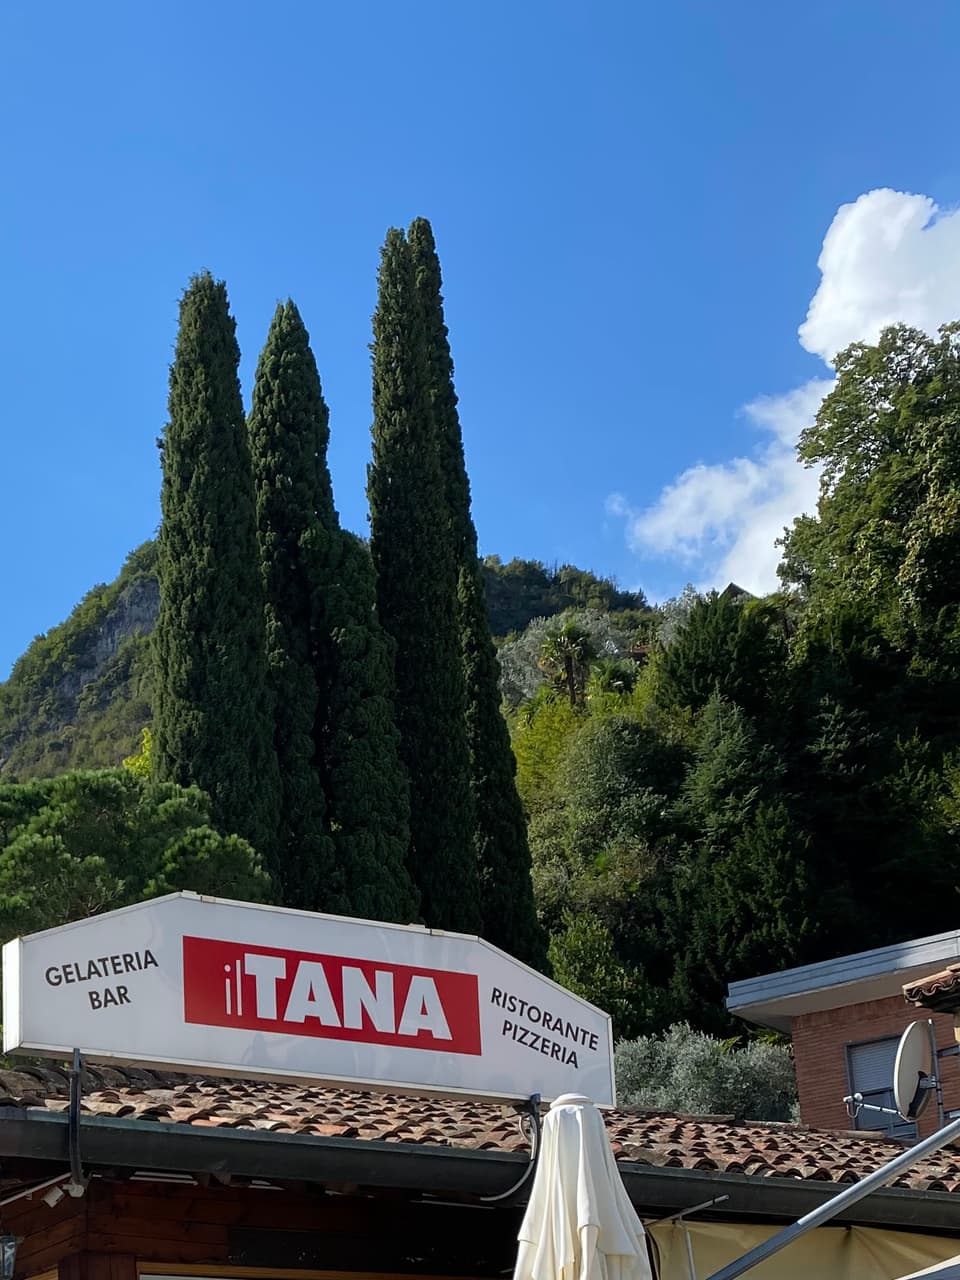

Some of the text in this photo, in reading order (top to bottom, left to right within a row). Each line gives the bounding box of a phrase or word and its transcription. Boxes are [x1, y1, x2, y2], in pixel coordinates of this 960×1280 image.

[45, 949, 159, 987] GELATERIA
[88, 985, 131, 1010] BAR
[224, 951, 453, 1041] il TANA
[490, 987, 600, 1051] RISTORANTE
[502, 1019, 579, 1069] PIZZERIA
